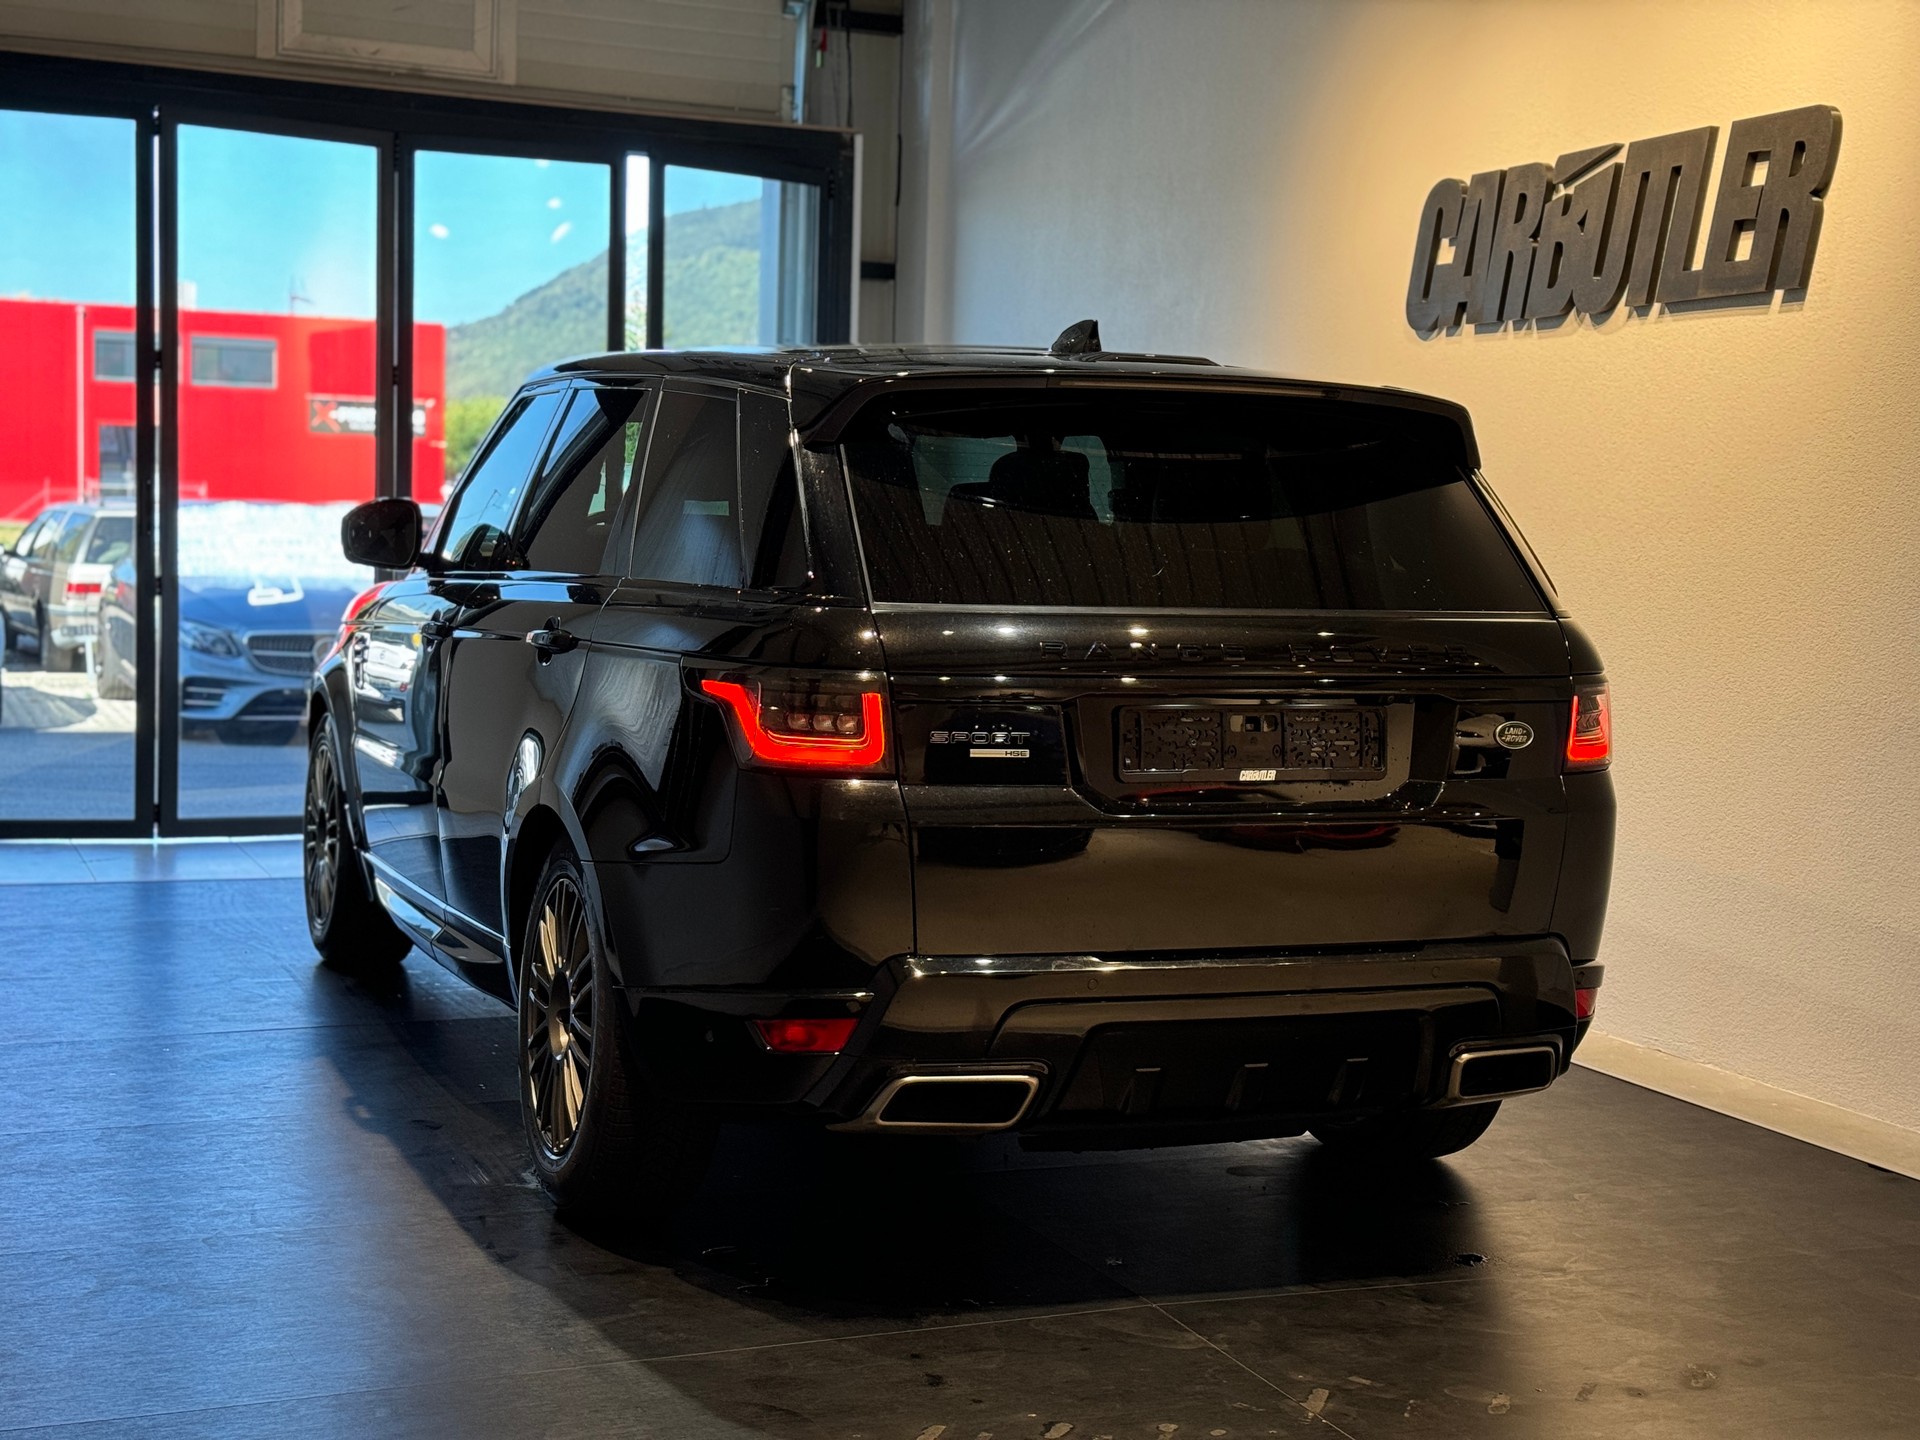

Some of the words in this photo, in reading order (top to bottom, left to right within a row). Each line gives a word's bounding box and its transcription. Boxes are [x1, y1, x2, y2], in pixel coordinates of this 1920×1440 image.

[1406, 104, 1843, 332] CARBUTLER
[1039, 641, 1247, 662] RANGE
[1288, 643, 1470, 663] ROVER
[929, 730, 1031, 744] SPORT
[1504, 727, 1523, 735] LAND
[1504, 735, 1528, 743] ROVER
